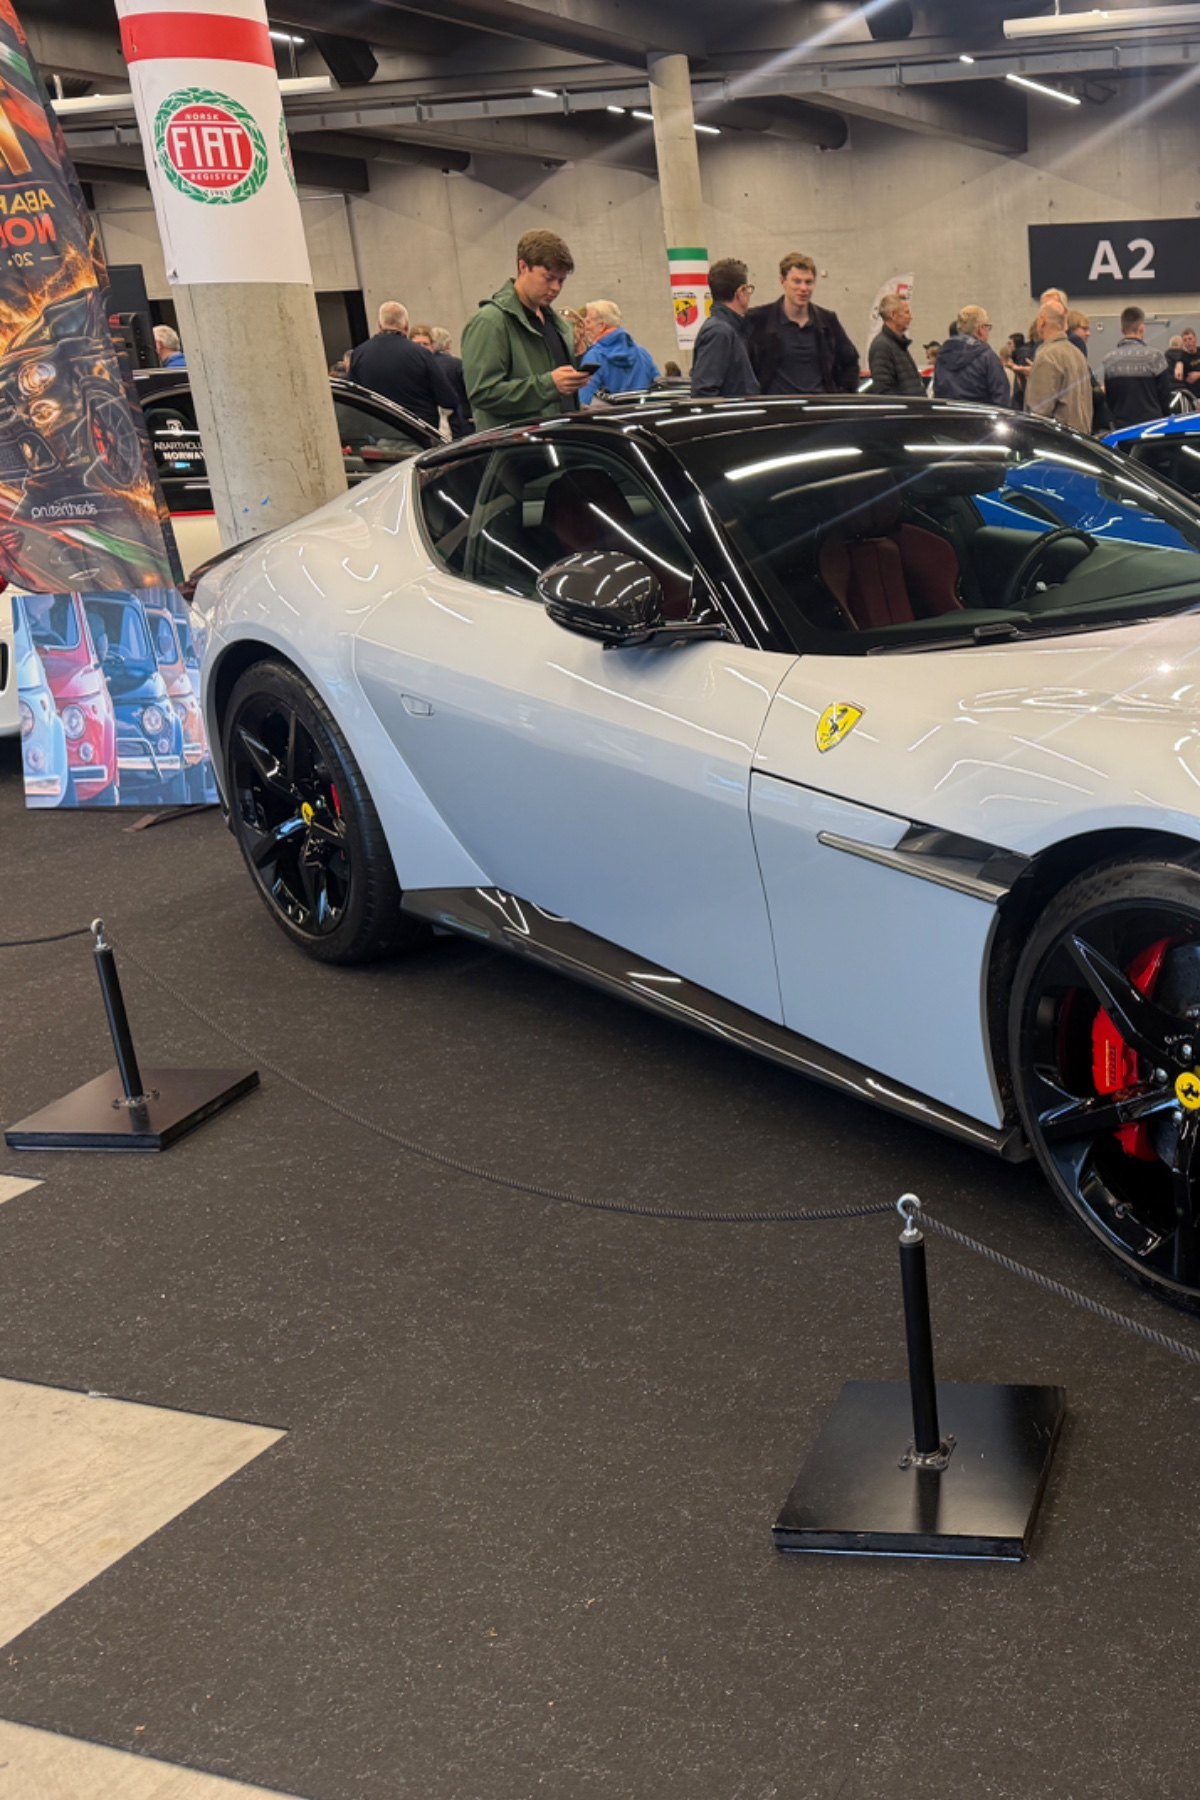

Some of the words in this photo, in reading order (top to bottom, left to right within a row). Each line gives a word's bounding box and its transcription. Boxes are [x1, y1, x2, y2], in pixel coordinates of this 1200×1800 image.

[185, 112, 219, 120] NORSK
[171, 126, 243, 168] FIAT
[190, 172, 240, 181] REGISTER
[1088, 238, 1156, 280] A2
